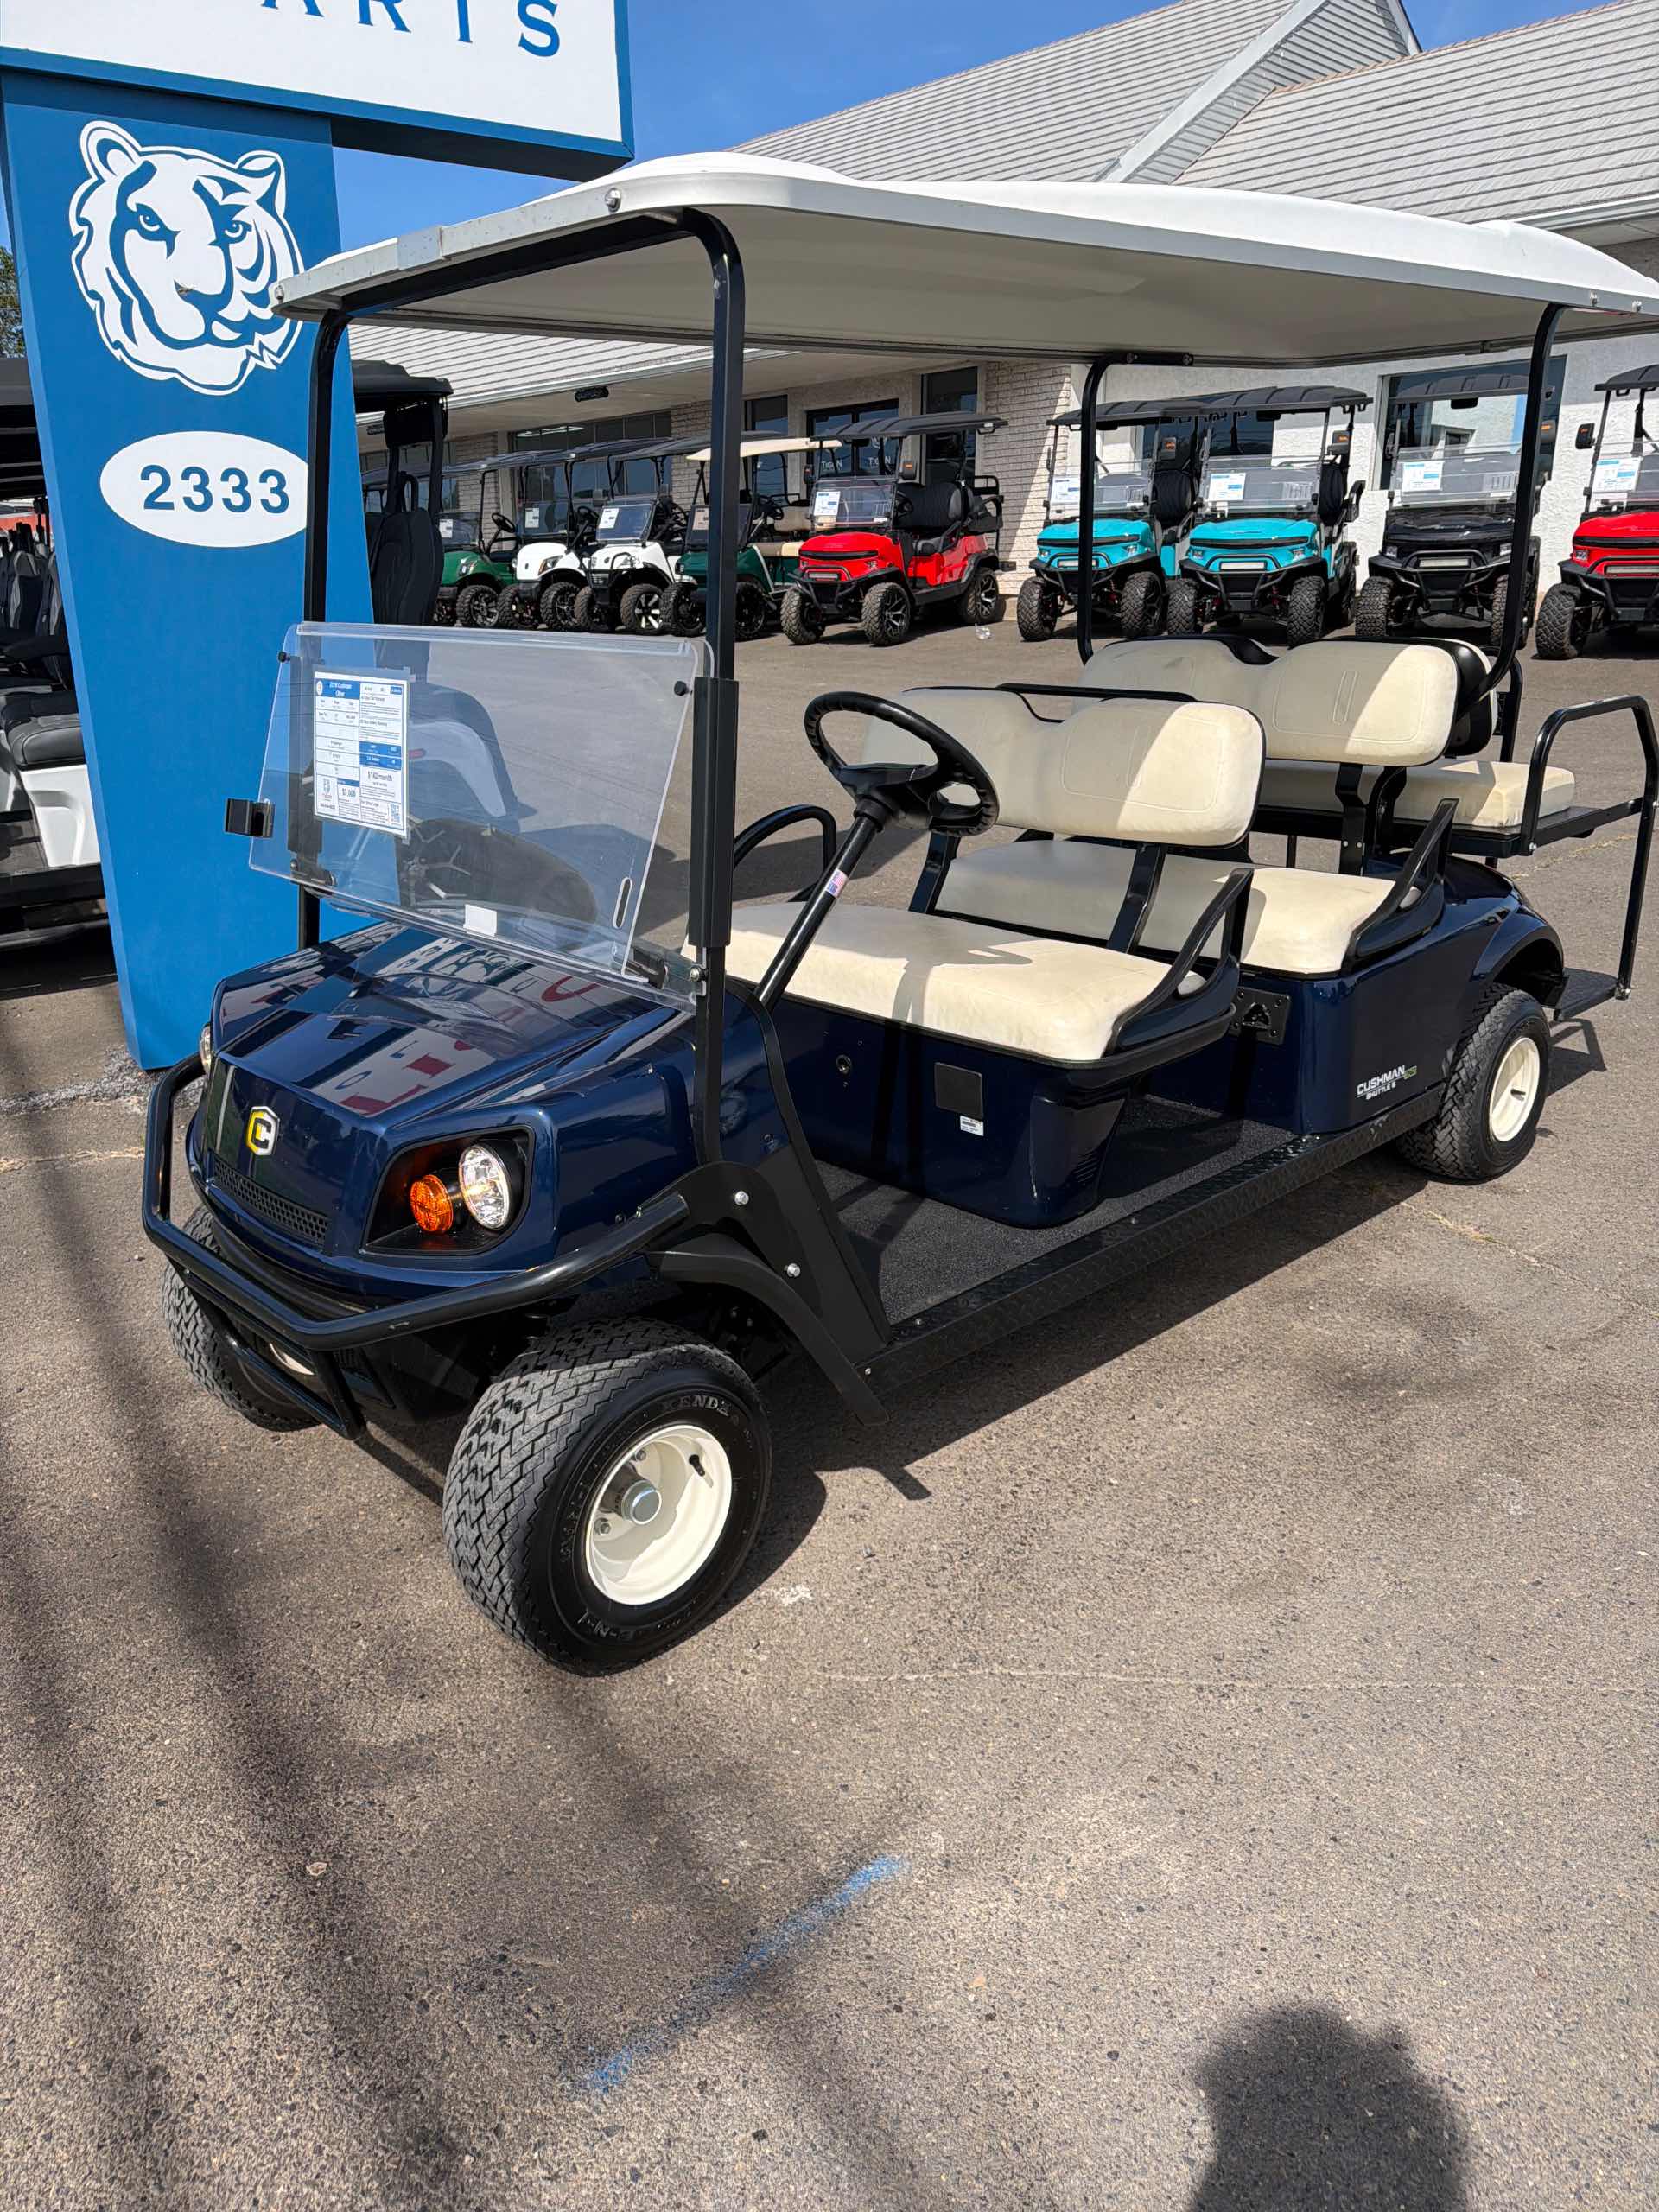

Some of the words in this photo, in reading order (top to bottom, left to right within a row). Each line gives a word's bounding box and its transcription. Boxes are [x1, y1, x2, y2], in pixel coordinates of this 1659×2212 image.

[821, 459, 843, 470] TIGN
[140, 464, 290, 515] 2333
[1357, 1065, 1406, 1096] CUSHMAN
